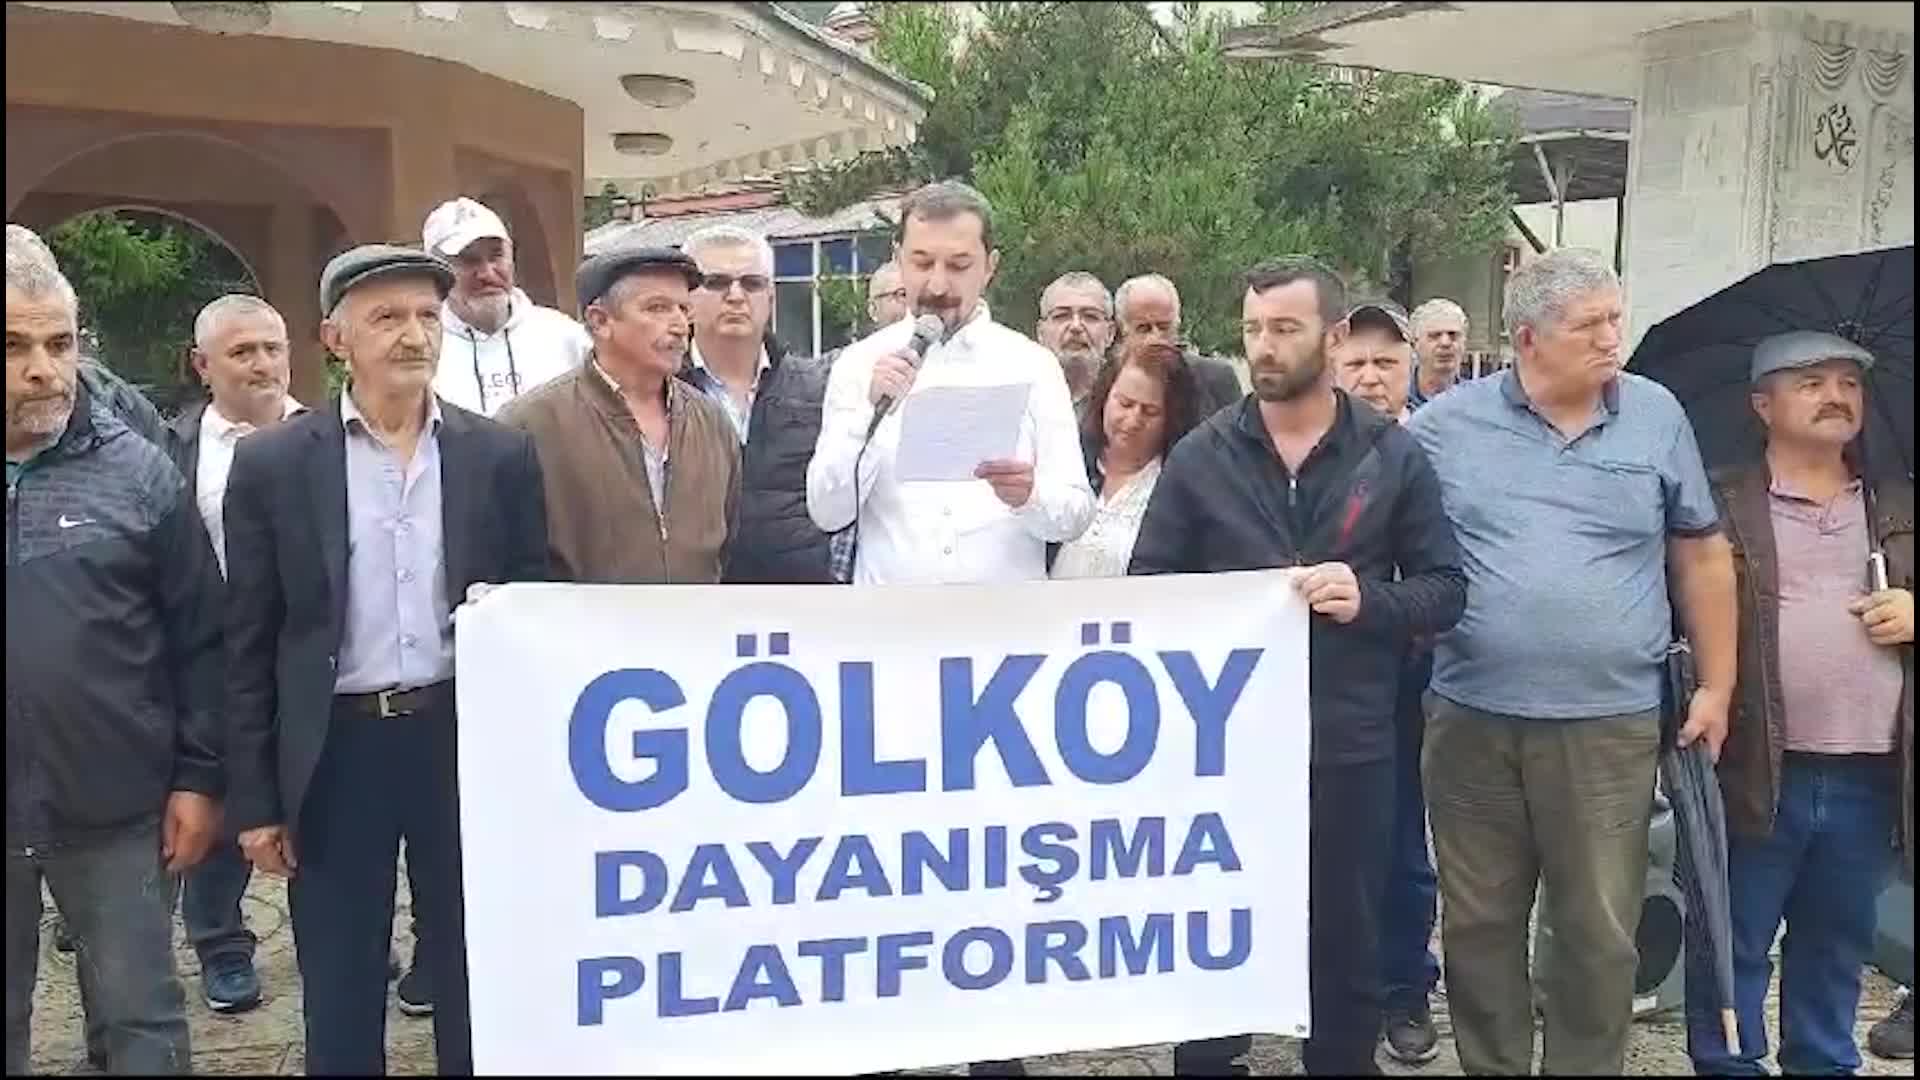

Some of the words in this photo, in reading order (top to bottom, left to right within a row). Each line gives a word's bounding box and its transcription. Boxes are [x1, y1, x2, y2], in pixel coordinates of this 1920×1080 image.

[568, 622, 1265, 812] GÖLKÖY
[594, 812, 1243, 918] DAYANIŞMA
[577, 908, 1253, 1026] PLATFORMU
